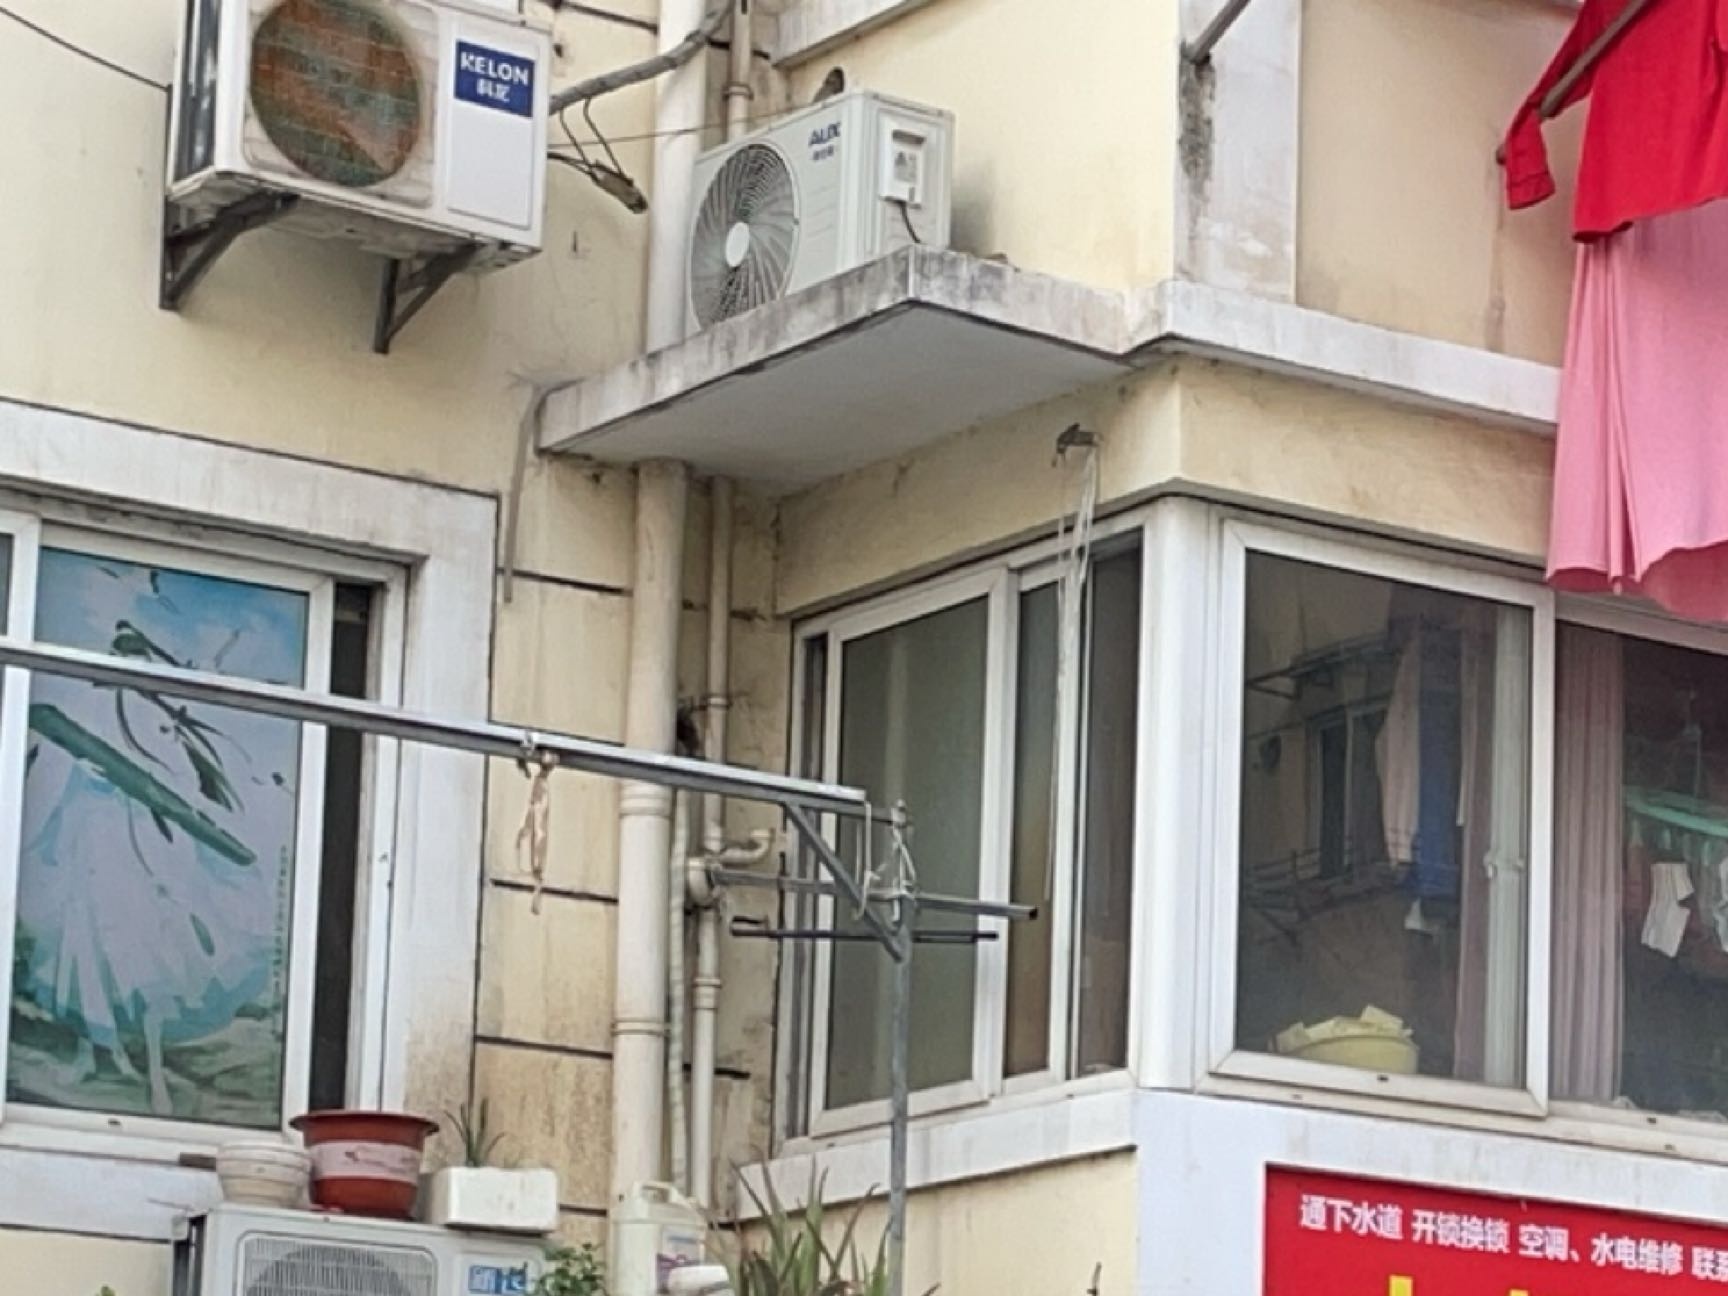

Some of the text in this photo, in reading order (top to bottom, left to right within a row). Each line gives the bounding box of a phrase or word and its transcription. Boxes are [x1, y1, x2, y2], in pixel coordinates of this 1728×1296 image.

[460, 51, 529, 86] KELON
[1300, 1194, 1403, 1240] 通下水道
[1411, 1209, 1511, 1254] 开锁换锁
